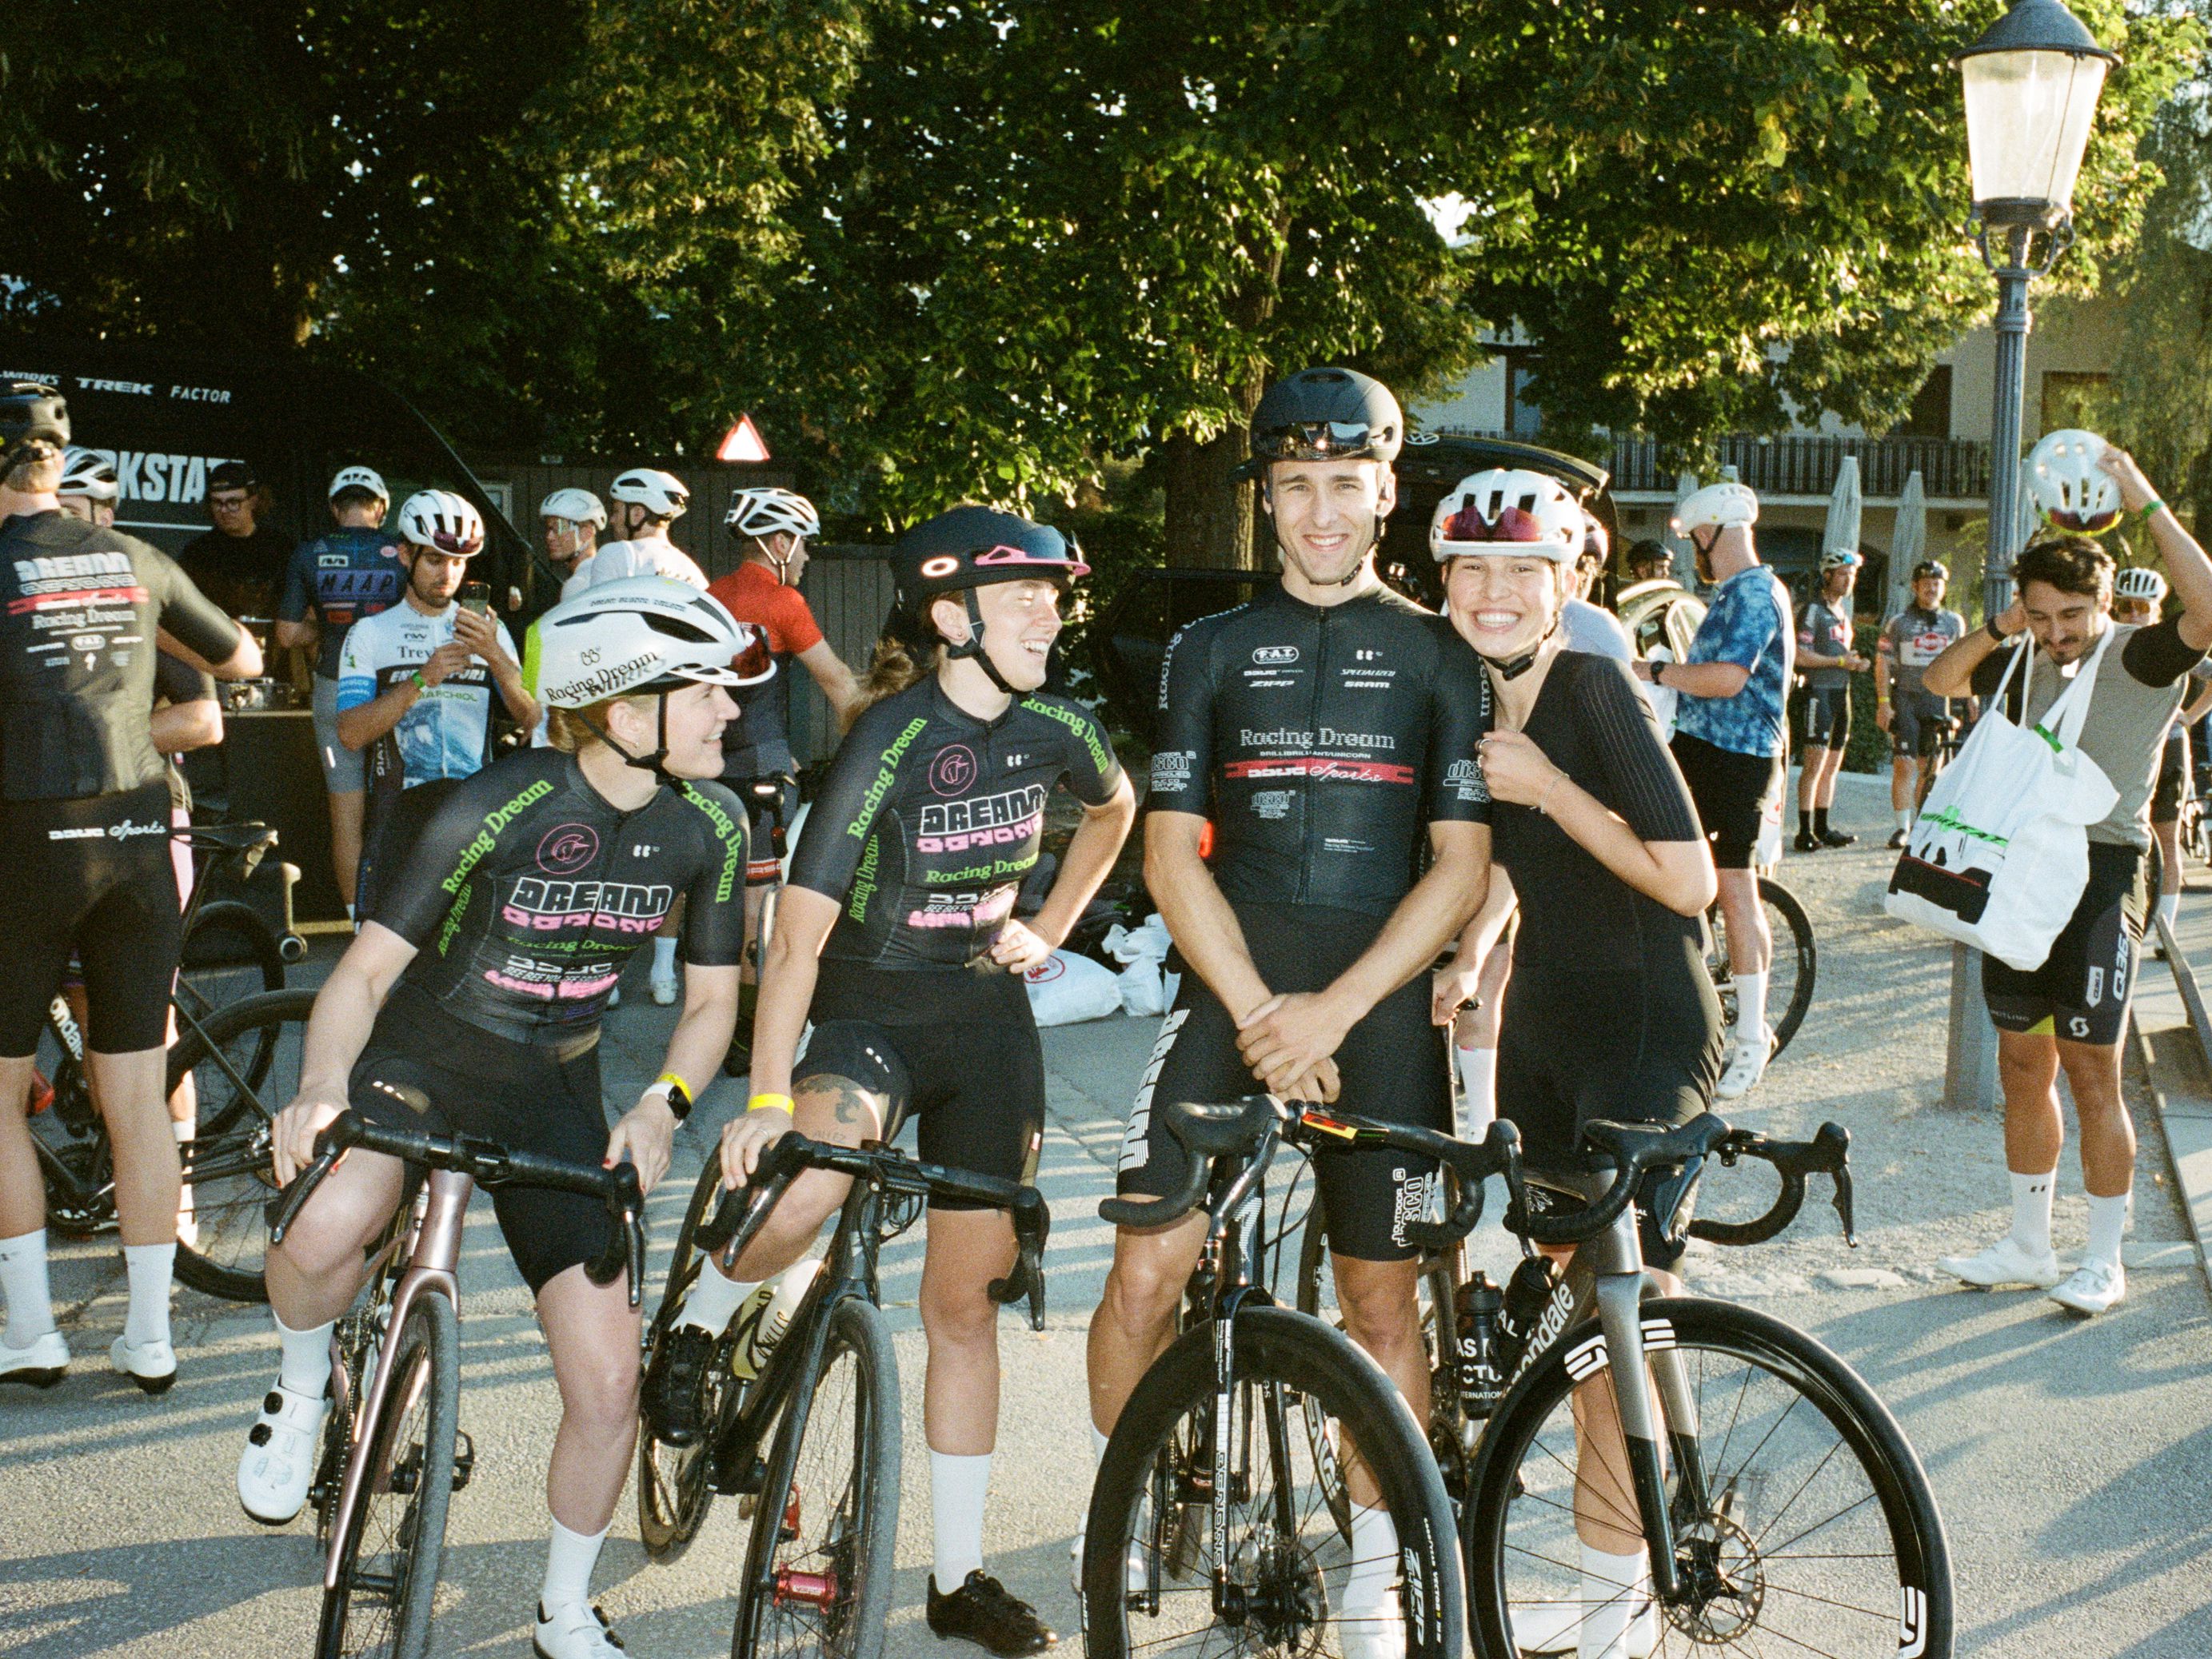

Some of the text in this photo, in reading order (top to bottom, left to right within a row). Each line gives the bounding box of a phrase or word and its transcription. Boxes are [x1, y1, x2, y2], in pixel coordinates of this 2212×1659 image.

[76, 377, 154, 395] TREK
[170, 385, 231, 404] FACTOR
[321, 572, 393, 592] MAAP
[545, 652, 660, 702] Racing Dream
[1020, 697, 1110, 775] Racing Dream
[1240, 728, 1395, 749] Racing Dream
[847, 717, 928, 839] Racing Dream
[1309, 762, 1383, 782] Sports
[920, 784, 1046, 835] DREAM
[441, 780, 553, 895] Racing Dream
[715, 830, 742, 903] Dream
[924, 864, 992, 883] Racing
[509, 877, 673, 918] DREAM
[849, 879, 878, 923] Racing
[501, 965, 525, 978] BEE
[523, 969, 545, 982] BEE
[1393, 1188, 1403, 1234] OUTDOOR
[1423, 1517, 1435, 1567] GOODYEAR
[1409, 1548, 1425, 1646] ZIPP
